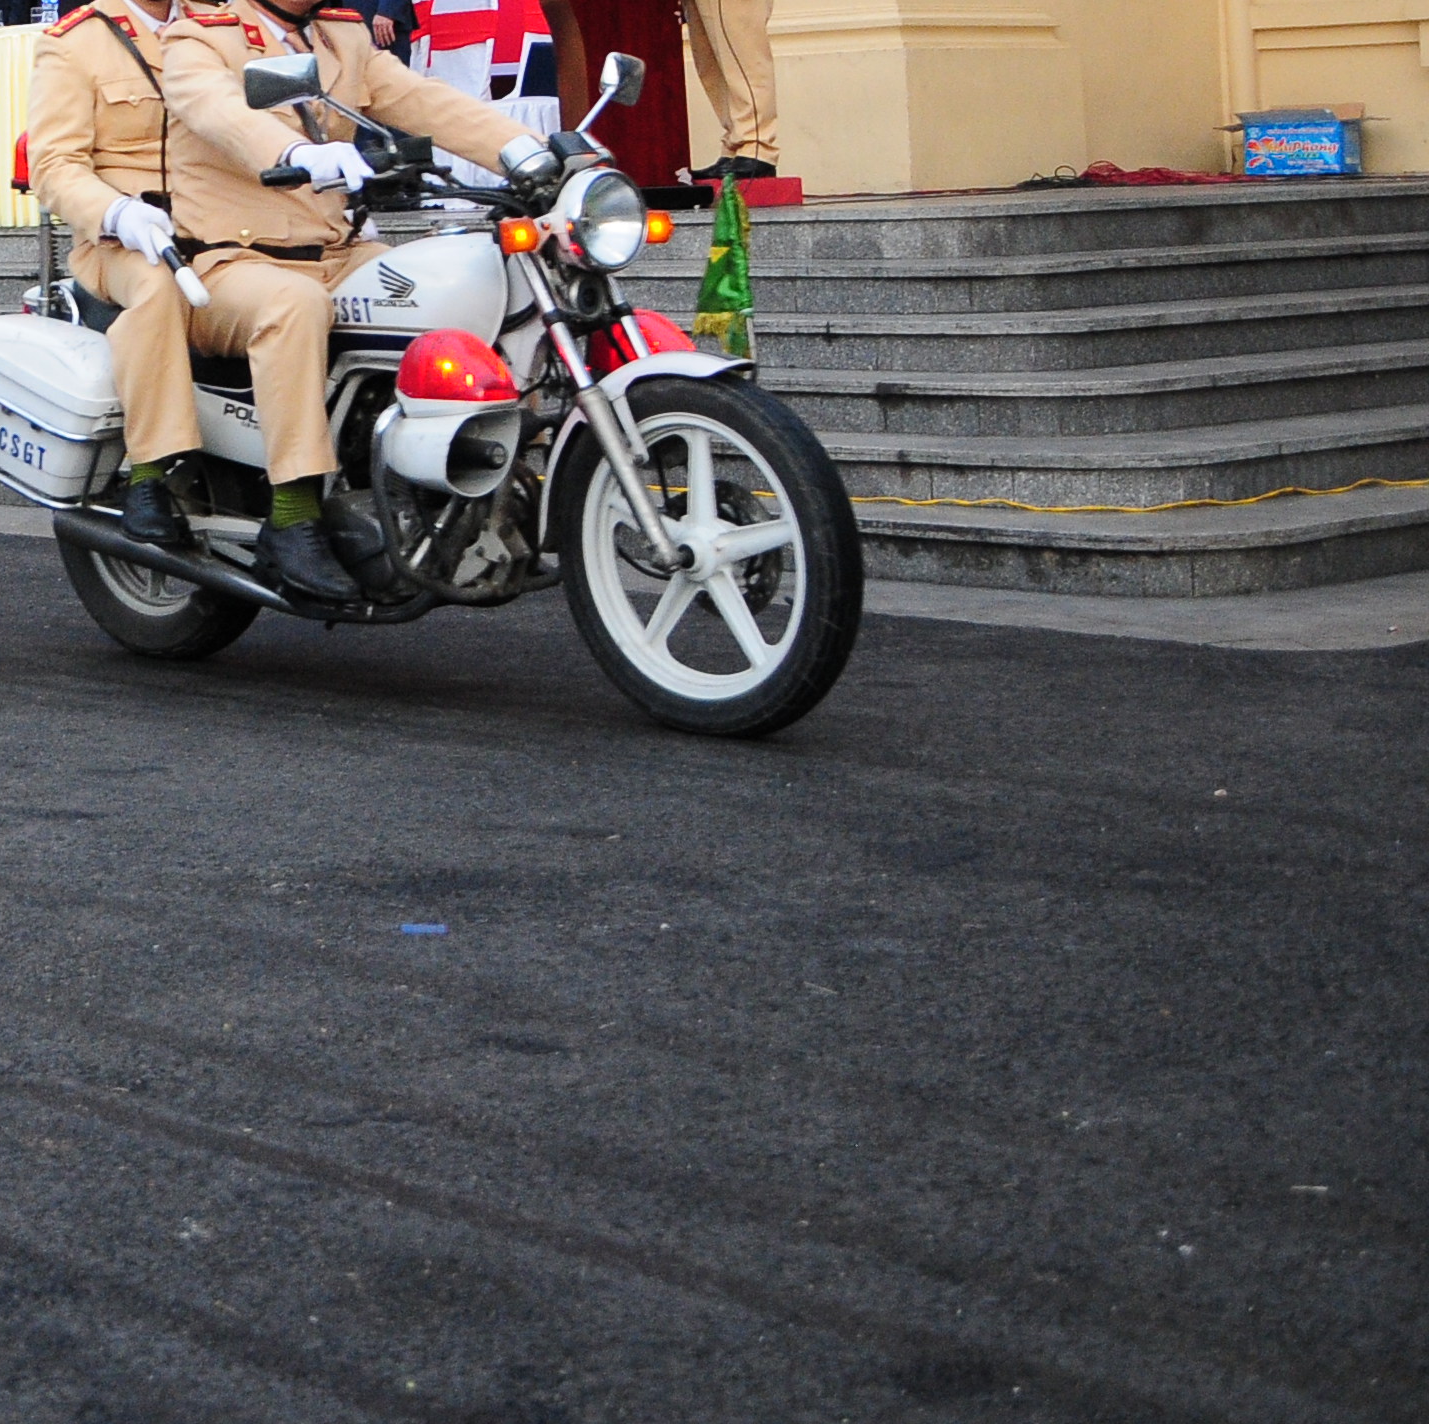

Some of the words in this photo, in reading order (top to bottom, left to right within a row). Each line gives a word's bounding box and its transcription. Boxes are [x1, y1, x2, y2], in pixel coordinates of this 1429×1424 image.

[372, 298, 419, 308] HONDA
[223, 402, 259, 424] POL
[0, 426, 46, 470] CSGT
